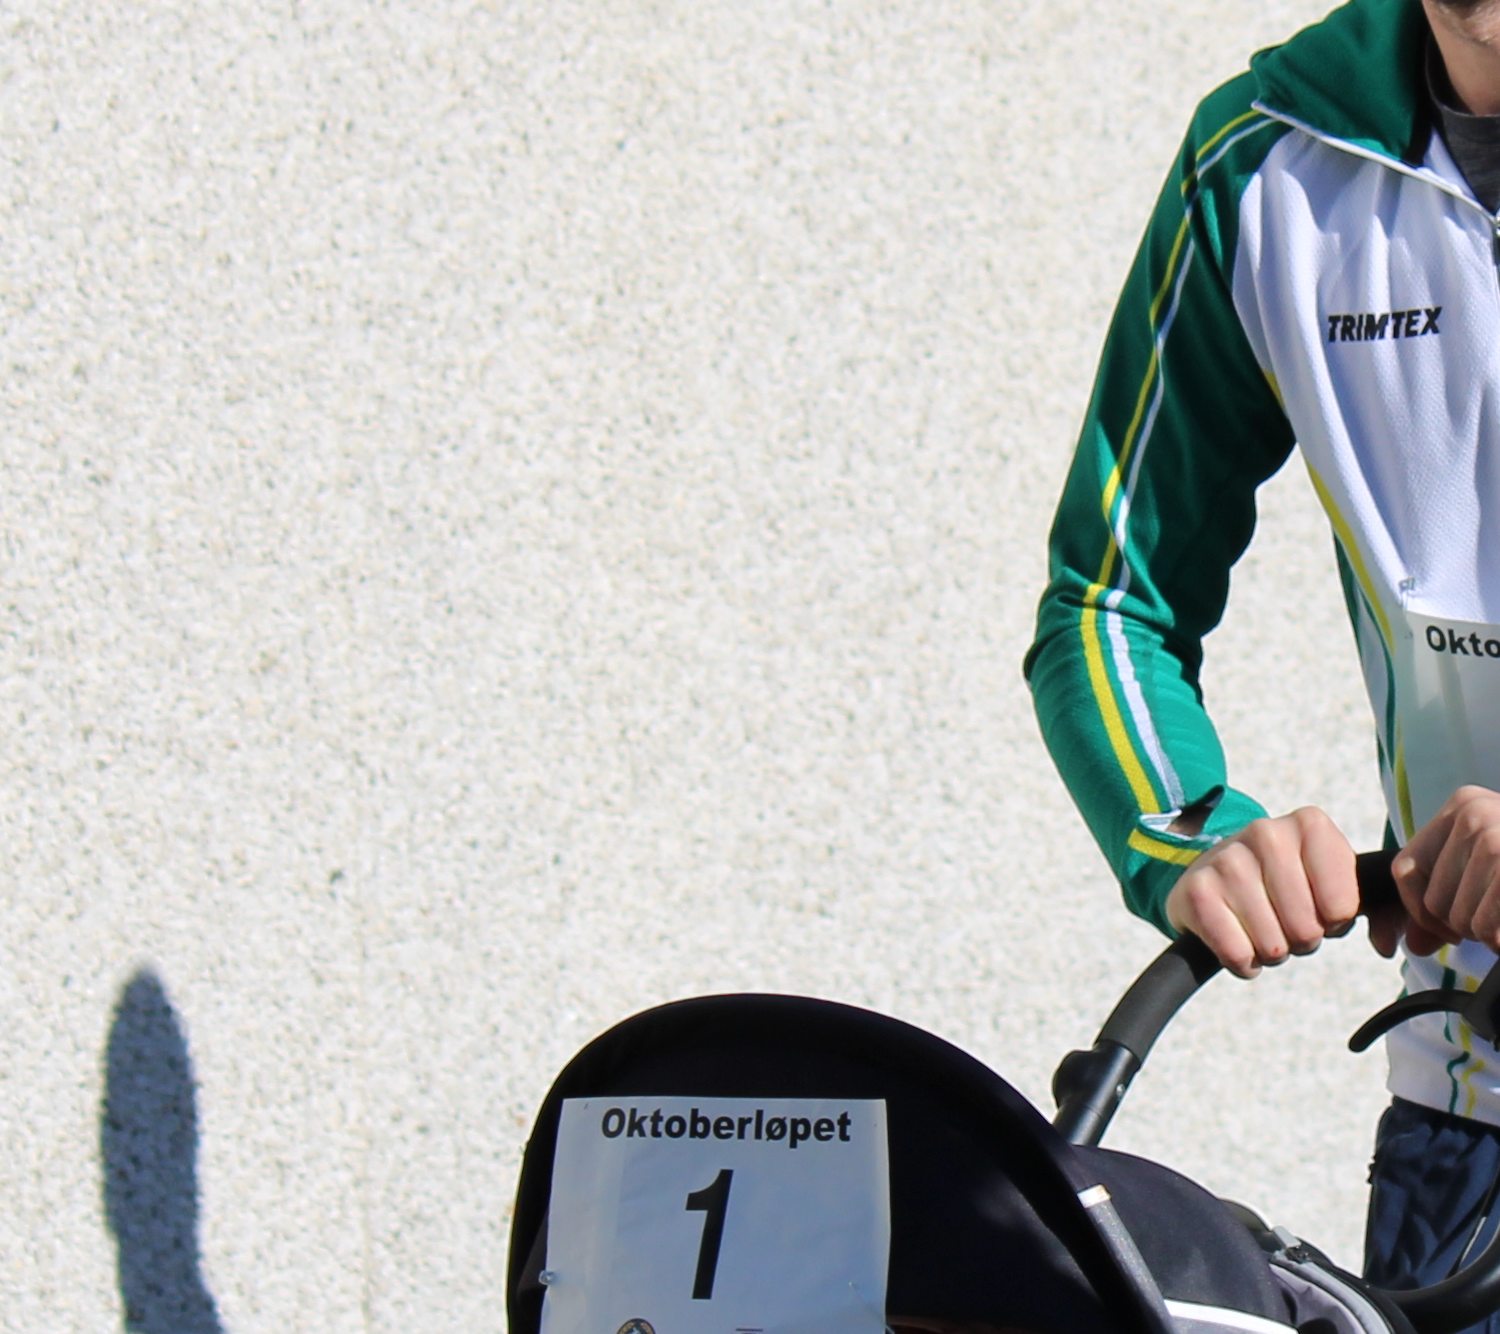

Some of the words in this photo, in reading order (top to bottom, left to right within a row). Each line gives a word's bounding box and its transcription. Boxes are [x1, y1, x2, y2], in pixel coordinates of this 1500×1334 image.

[1327, 304, 1444, 344] TRIMTEX
[601, 1106, 852, 1150] Oktoberløpet
[684, 1168, 735, 1301] 1
